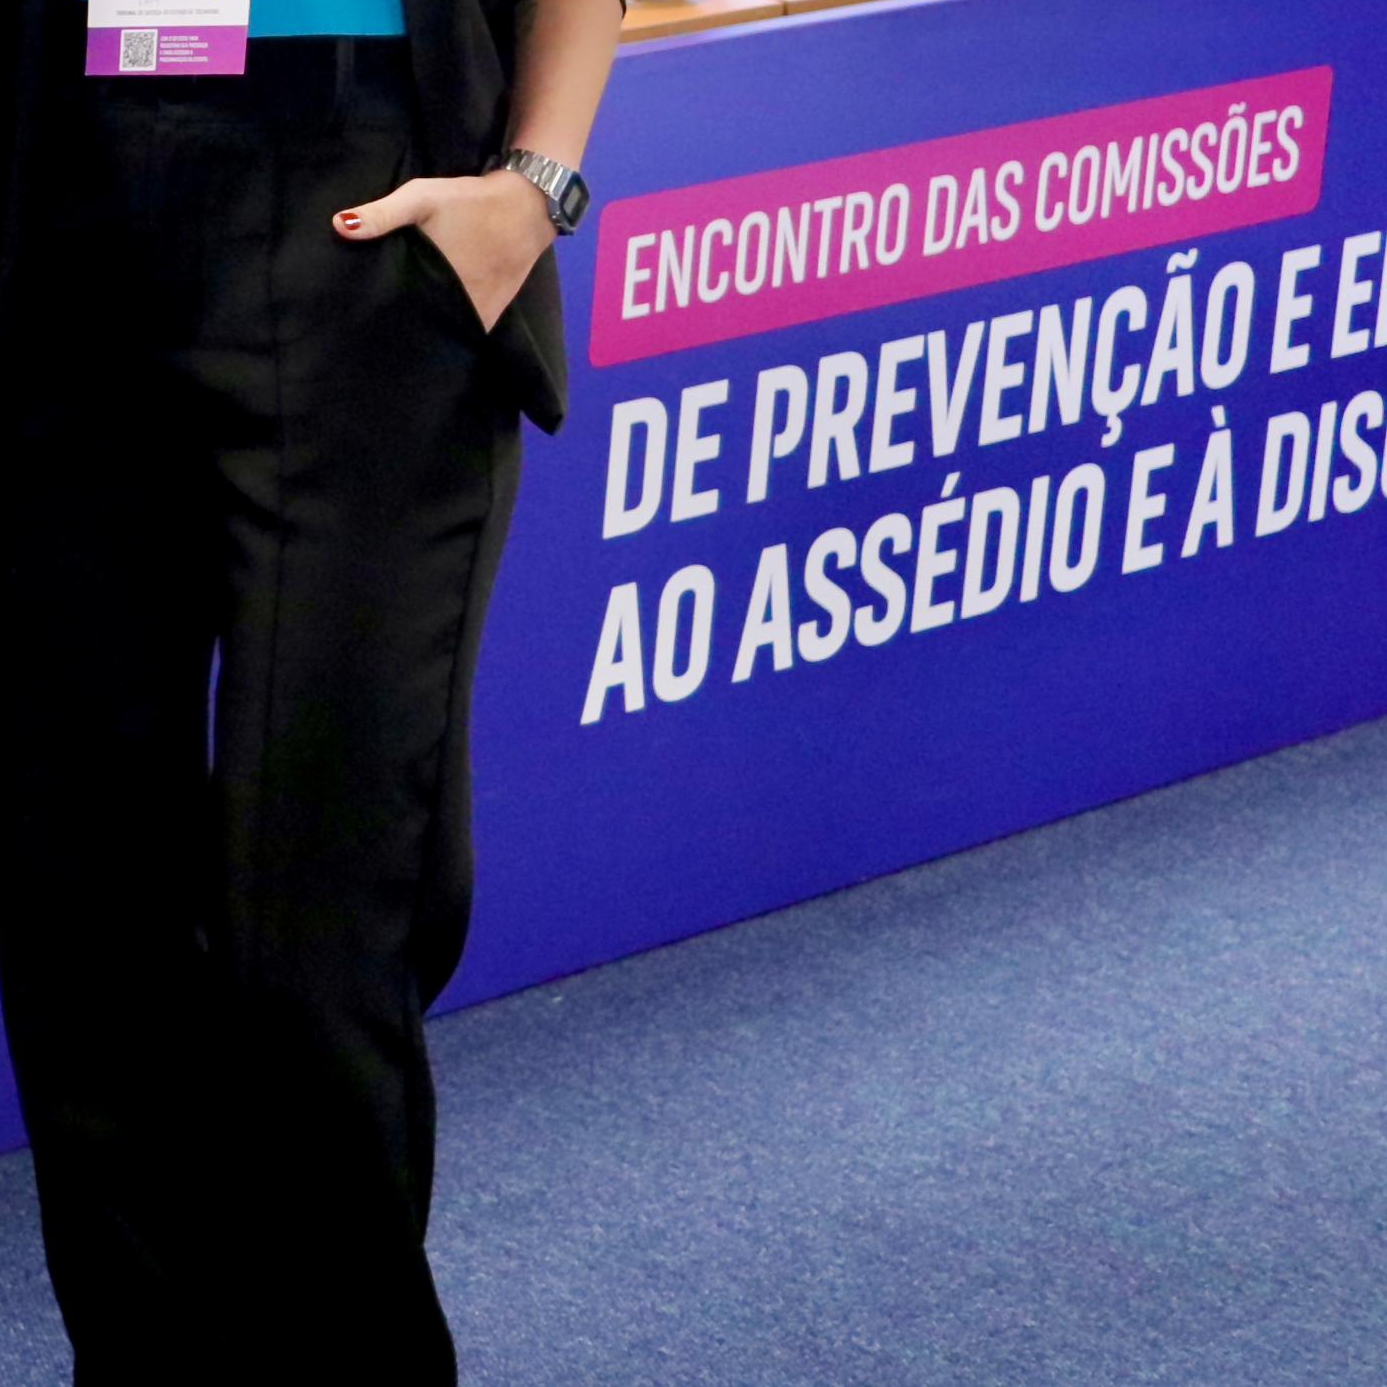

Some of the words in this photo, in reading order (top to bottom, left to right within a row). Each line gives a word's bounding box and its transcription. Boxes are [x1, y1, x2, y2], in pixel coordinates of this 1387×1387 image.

[622, 183, 909, 321] ENCONTRO
[923, 159, 1025, 258] DAS
[1034, 102, 1304, 234] COMISSÕES
[602, 380, 730, 540] DE
[746, 249, 1255, 505] PREVENÇÃO
[1270, 244, 1321, 375] E
[1330, 230, 1387, 359] E
[580, 564, 716, 725] AO
[731, 463, 1106, 684] ASSÉDIO
[1122, 444, 1175, 575] E
[1181, 406, 1235, 559] À
[1255, 390, 1387, 538] DIS
